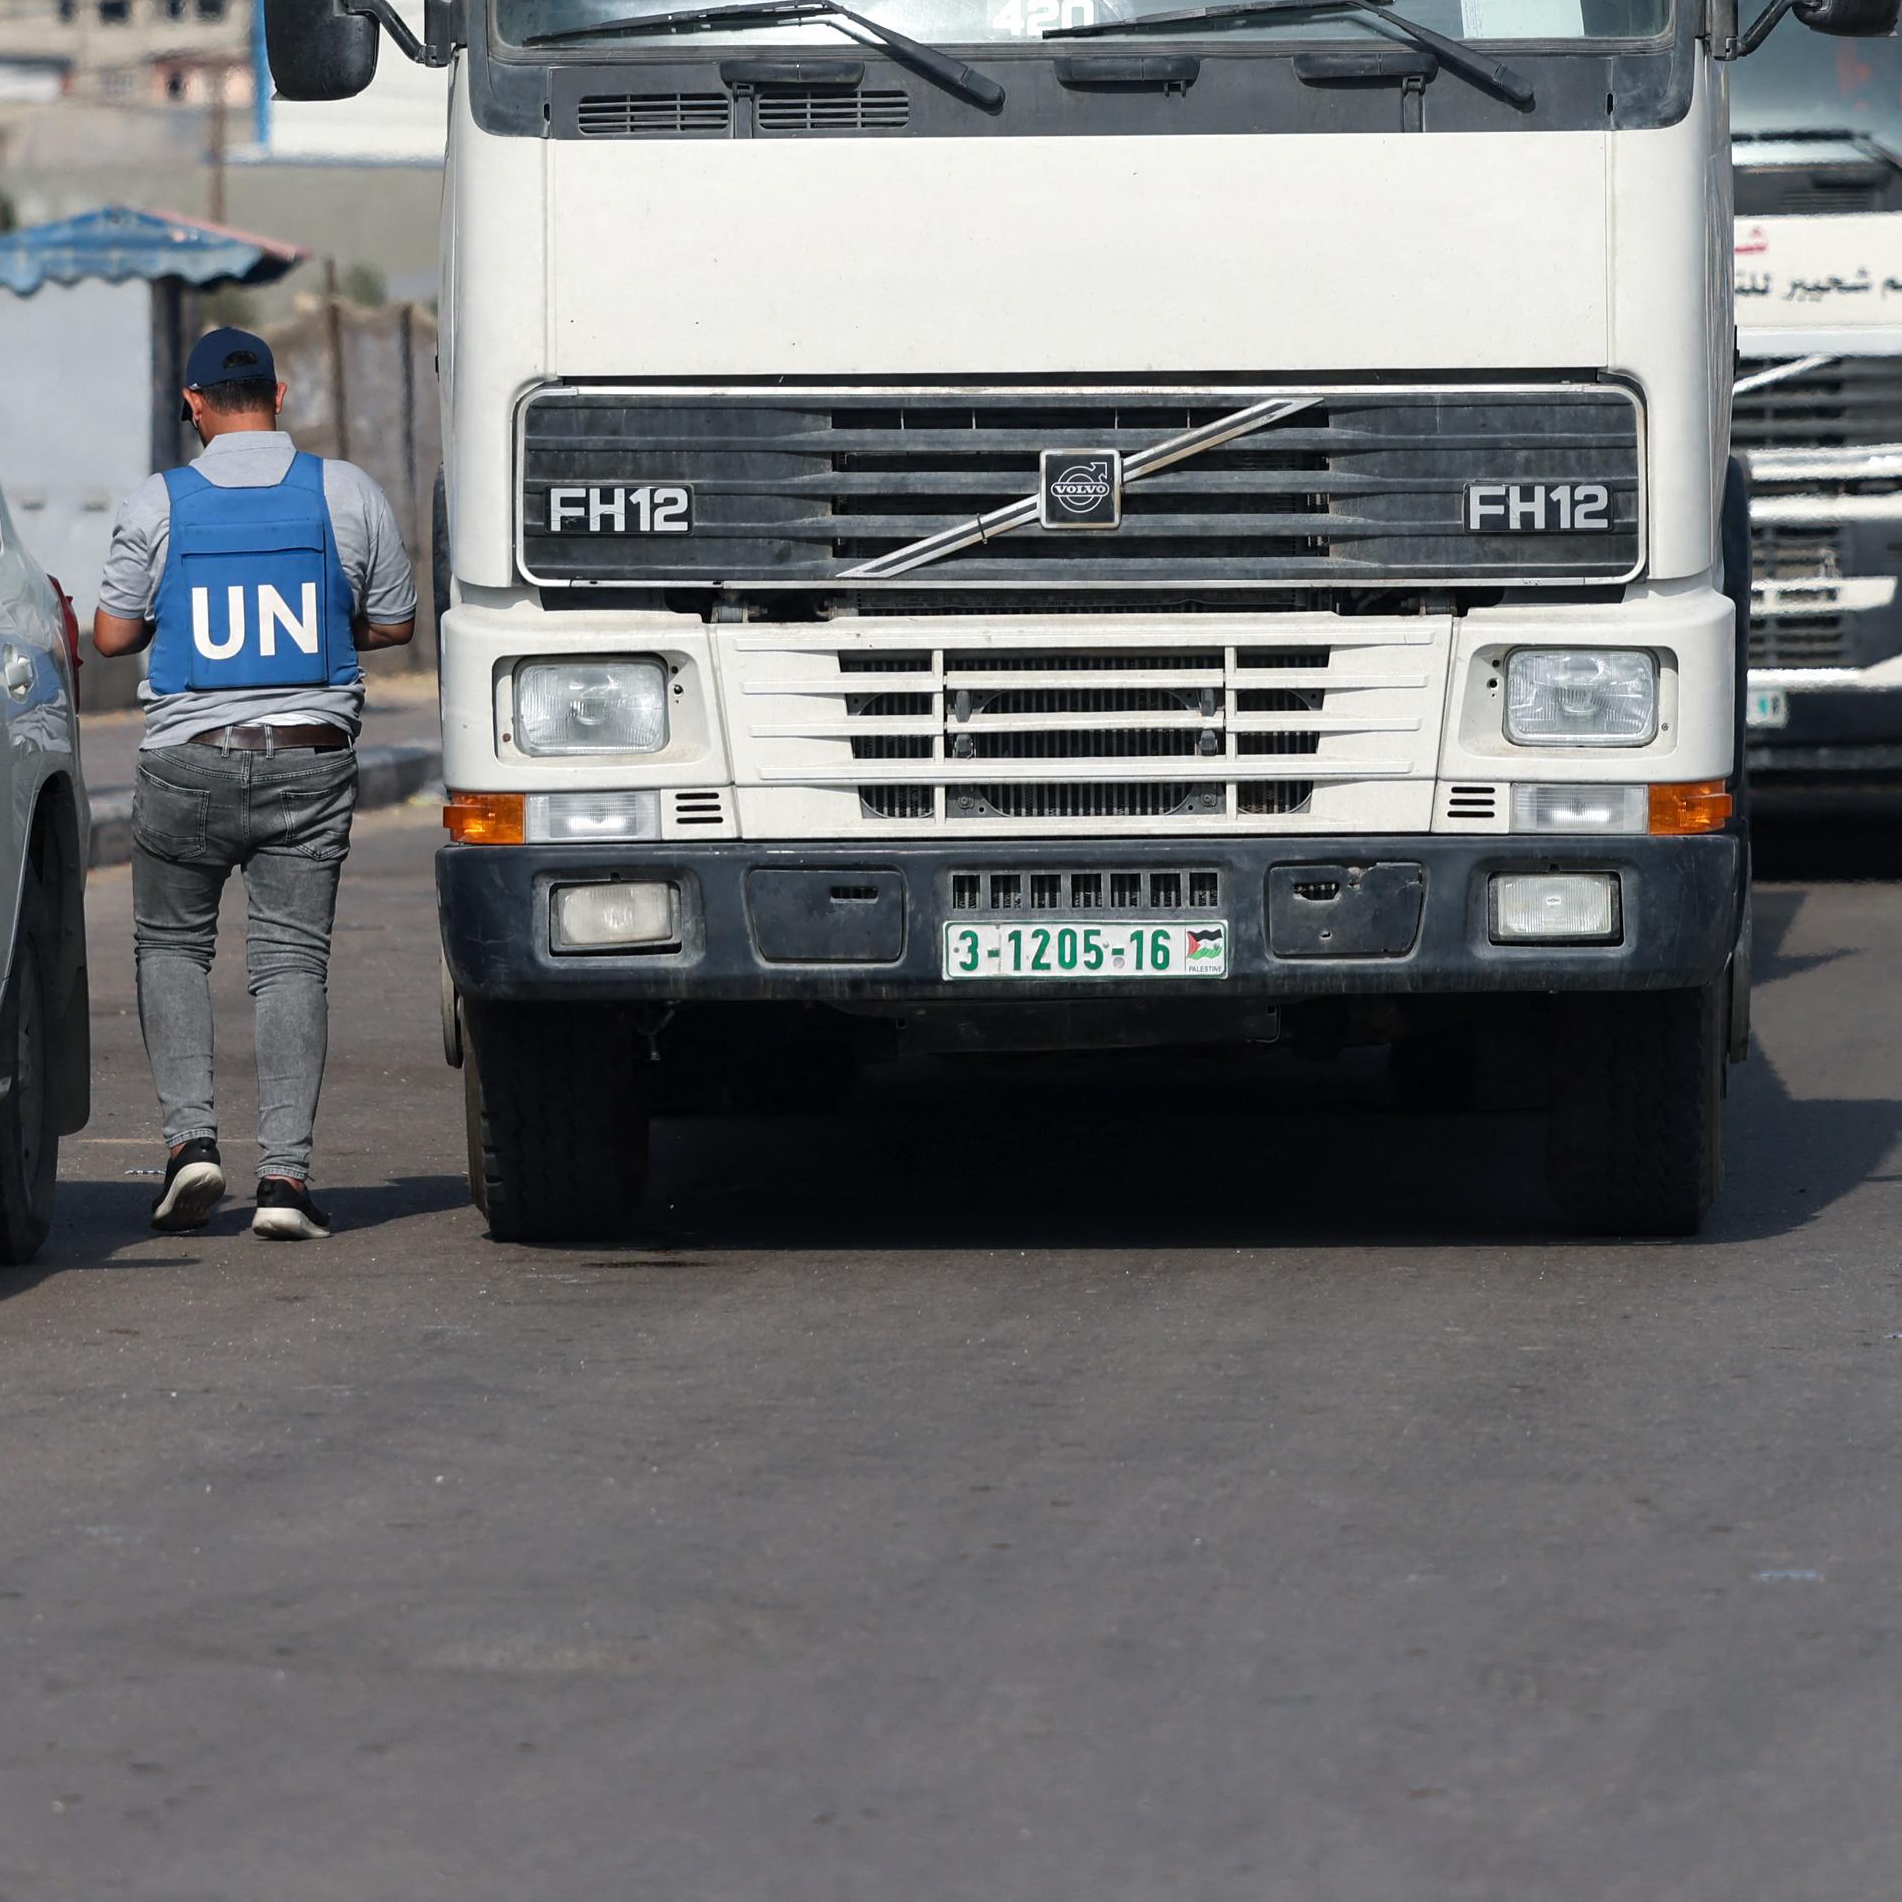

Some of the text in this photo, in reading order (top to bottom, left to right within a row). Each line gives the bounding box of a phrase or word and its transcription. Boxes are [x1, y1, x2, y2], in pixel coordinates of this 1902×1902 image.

[550, 487, 689, 532] FH12
[1054, 484, 1107, 495] VOLVO
[1469, 484, 1609, 530] FH12
[190, 582, 320, 660] UN
[958, 927, 1172, 972] 3-1205-16
[1188, 965, 1223, 973] PALESTINE
